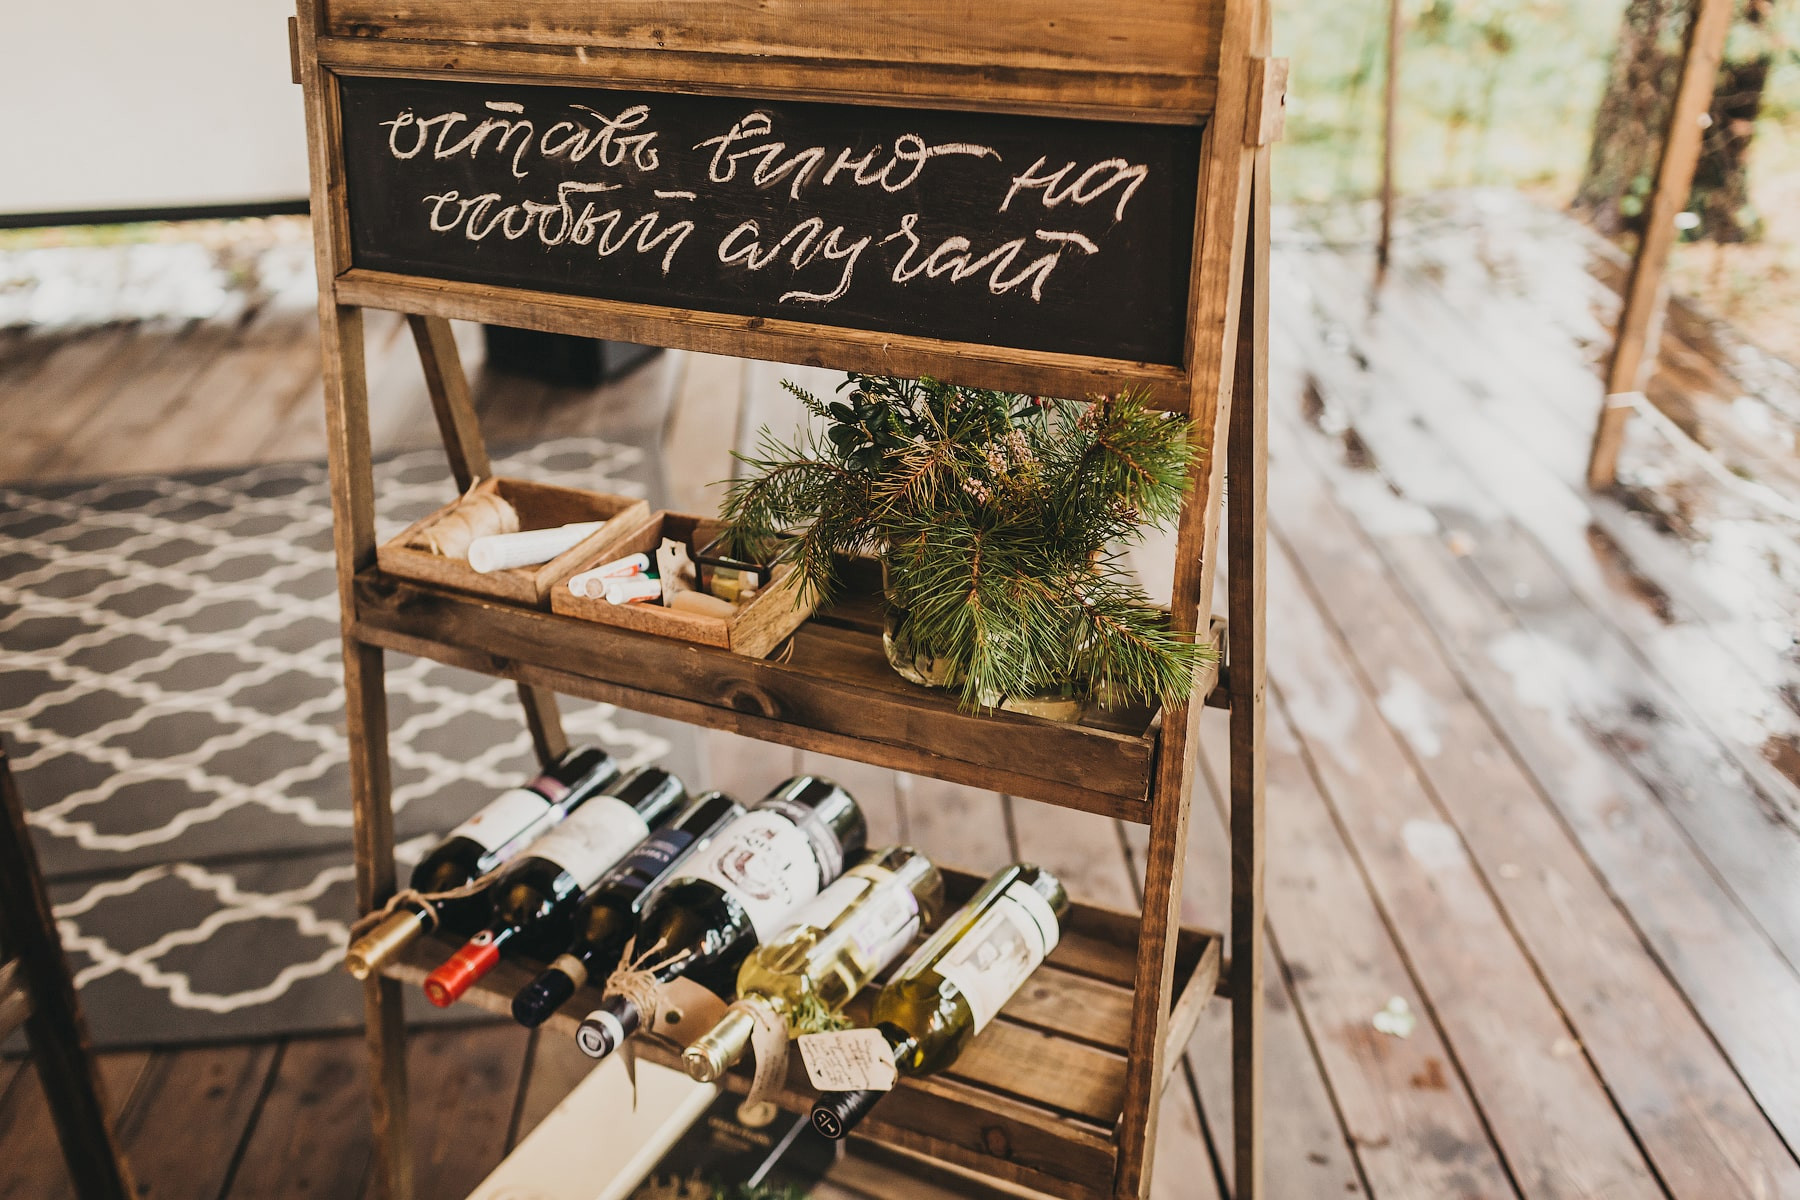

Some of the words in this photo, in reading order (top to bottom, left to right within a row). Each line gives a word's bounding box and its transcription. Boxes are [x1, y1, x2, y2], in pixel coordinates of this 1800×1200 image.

[378, 100, 660, 179] оставь
[692, 111, 1002, 201] вино
[998, 154, 1149, 222] на
[422, 180, 698, 275] особый
[717, 212, 1100, 305] случай
